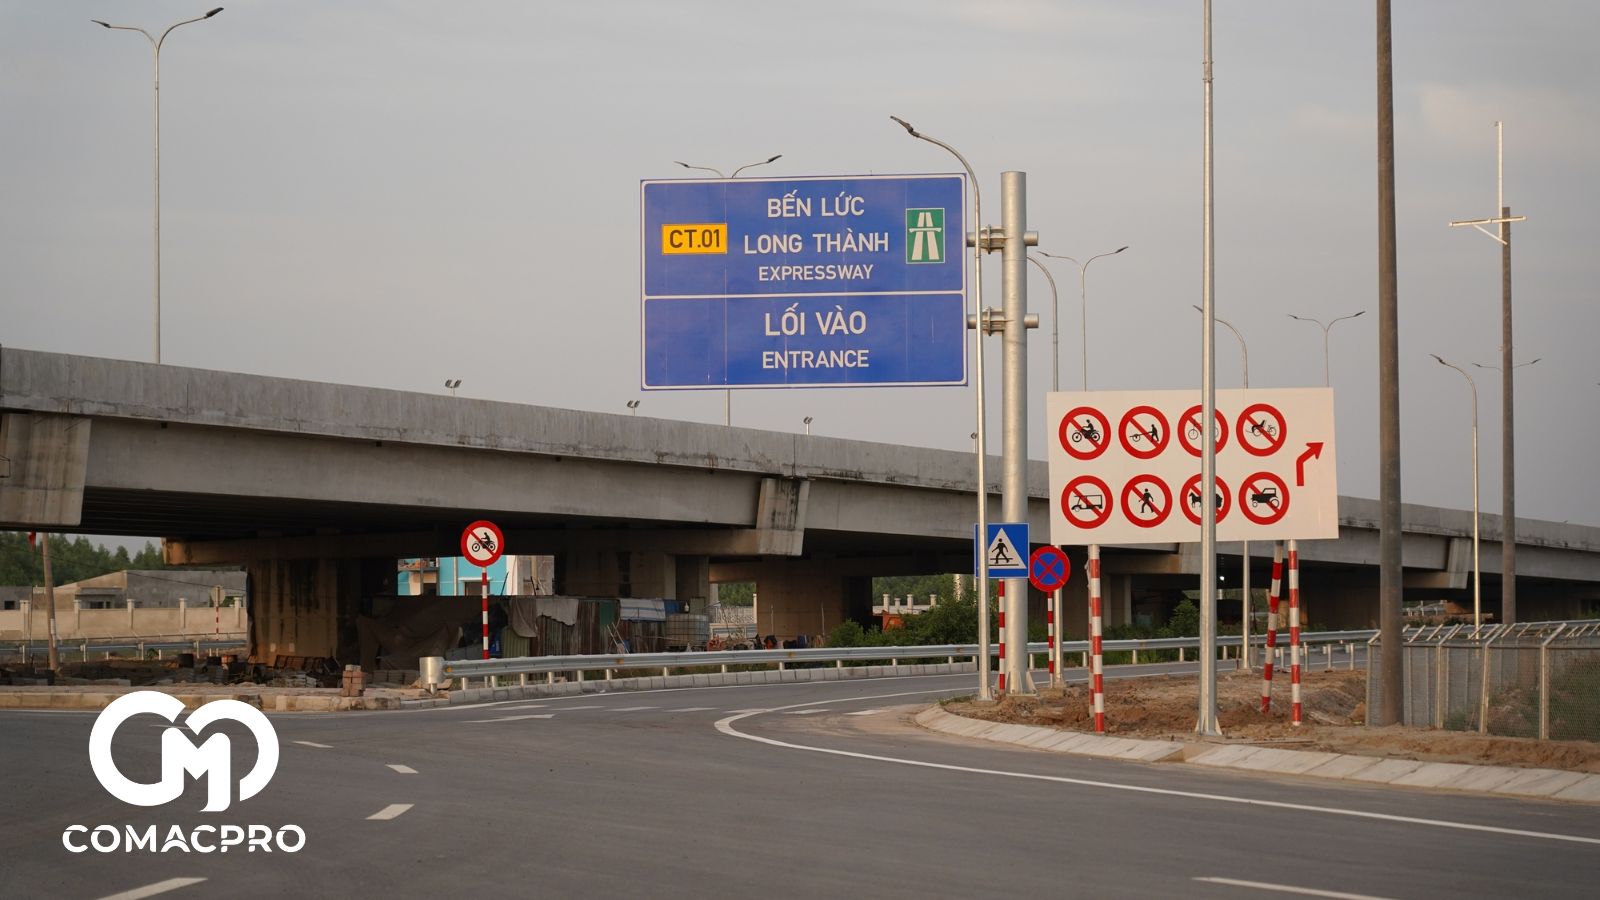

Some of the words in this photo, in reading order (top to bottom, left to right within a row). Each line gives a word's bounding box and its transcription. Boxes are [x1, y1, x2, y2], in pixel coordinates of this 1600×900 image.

[767, 190, 811, 218] BẾN
[821, 191, 865, 217] LỨC
[669, 229, 720, 249] CT.01
[744, 234, 803, 254] LONG
[812, 228, 889, 253] THÀNH
[758, 264, 874, 281] EXPRESSWAY
[765, 303, 805, 336] LỐI
[815, 305, 867, 335] VÀO
[762, 350, 869, 369] ENTRANCE
